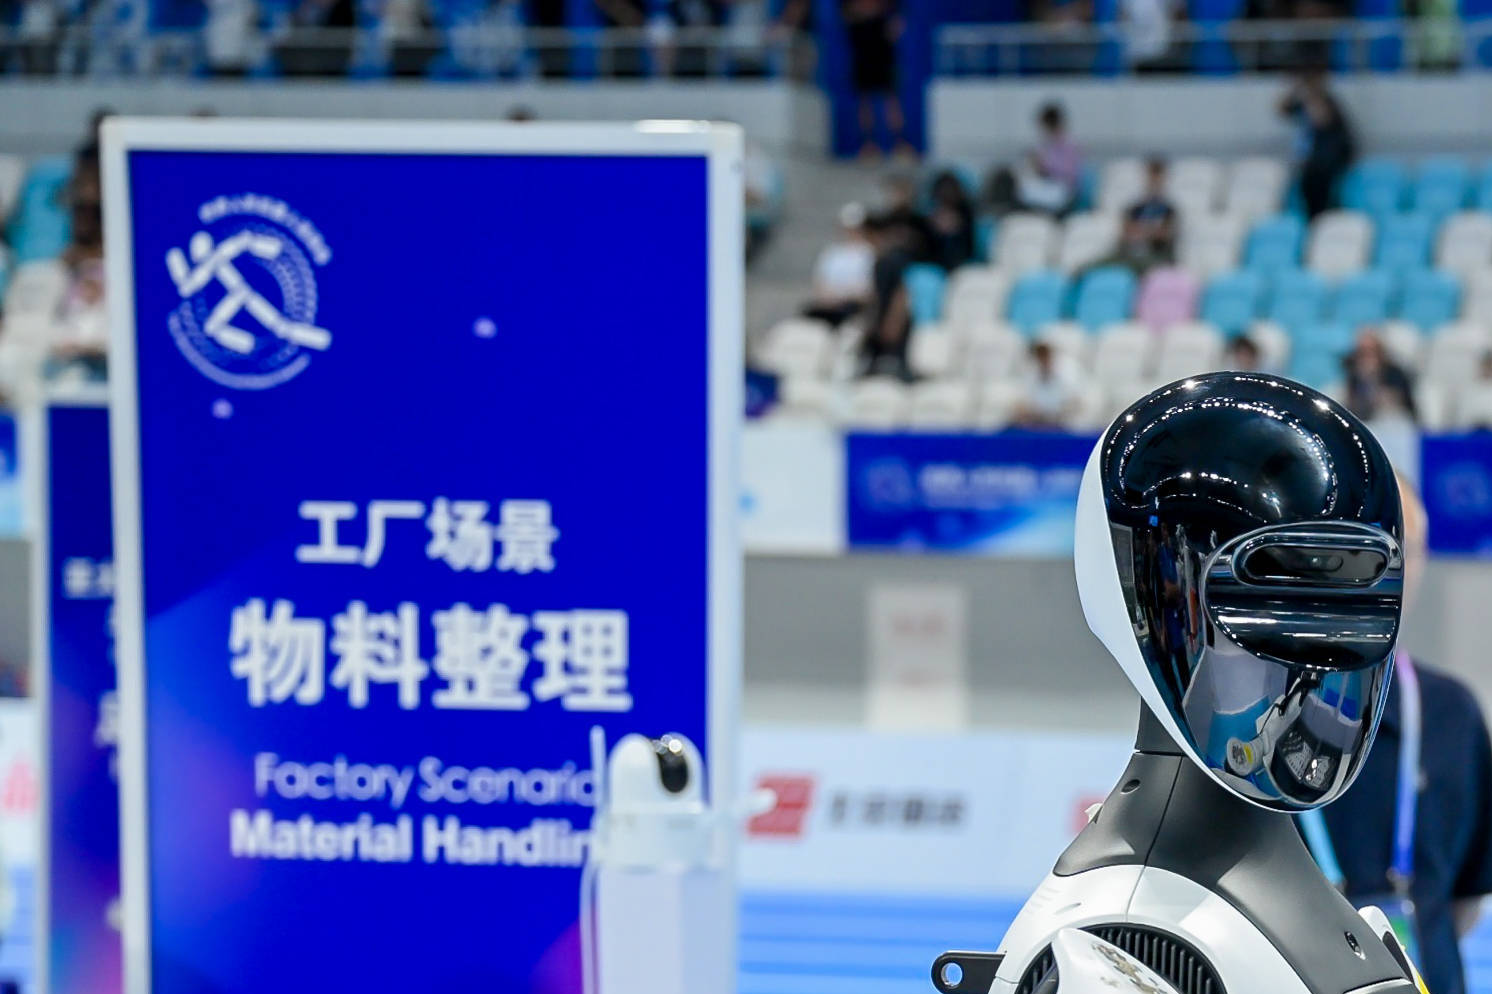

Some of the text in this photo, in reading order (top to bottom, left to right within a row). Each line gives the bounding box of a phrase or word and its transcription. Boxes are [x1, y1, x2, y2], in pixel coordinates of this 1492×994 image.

[296, 496, 561, 574] 工厂场景
[229, 598, 634, 713] 物料整理
[254, 751, 415, 810] Factory
[229, 807, 597, 868] Material Handlin
